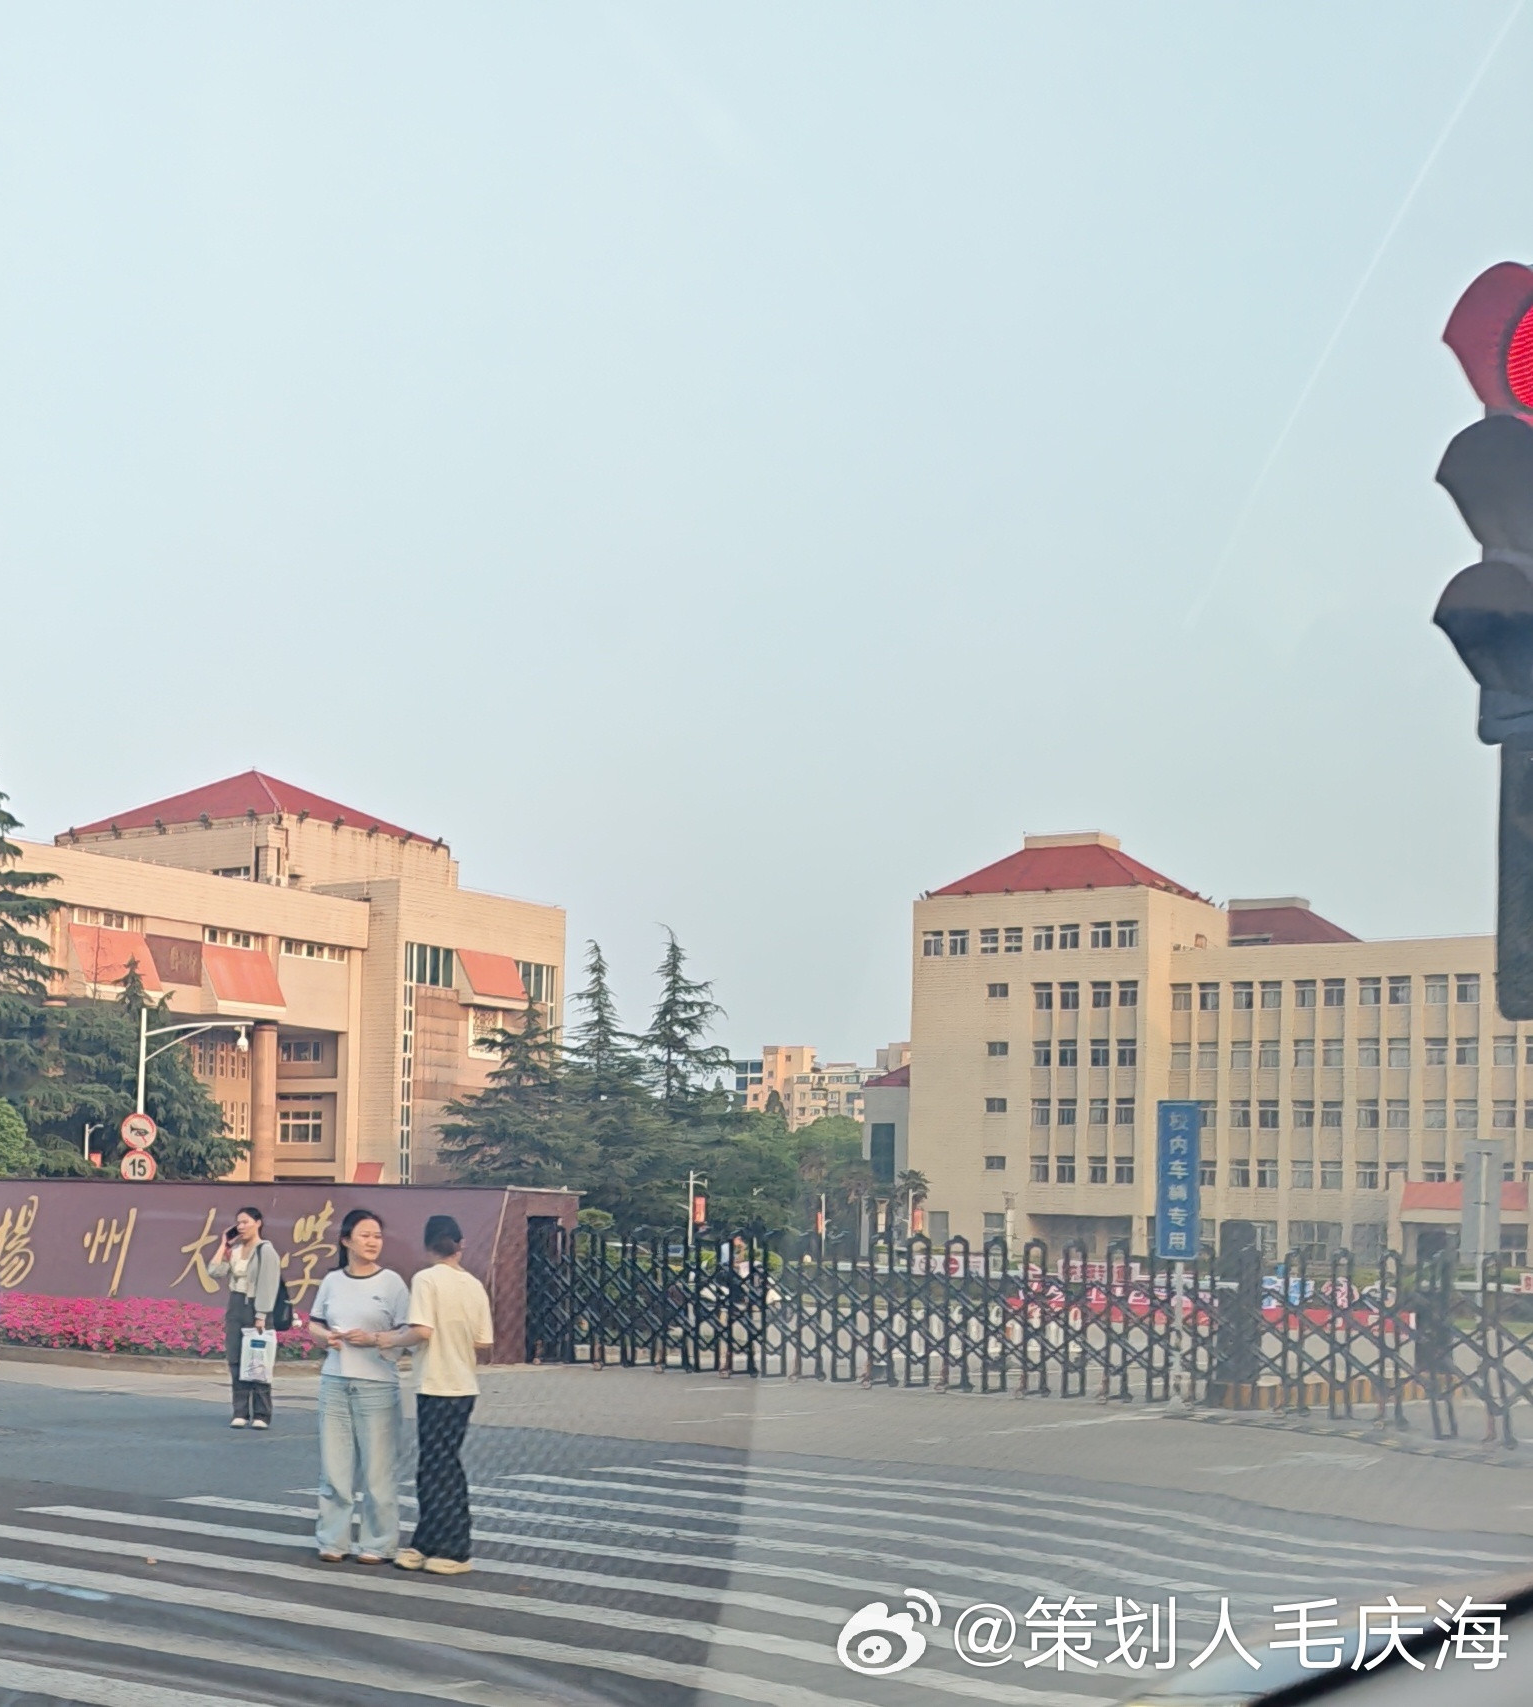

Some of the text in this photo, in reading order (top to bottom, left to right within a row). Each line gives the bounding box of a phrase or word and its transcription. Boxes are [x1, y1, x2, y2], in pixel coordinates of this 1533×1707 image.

[129, 1158, 146, 1176] 15
[1168, 1110, 1189, 1251] 校内车辆专用
